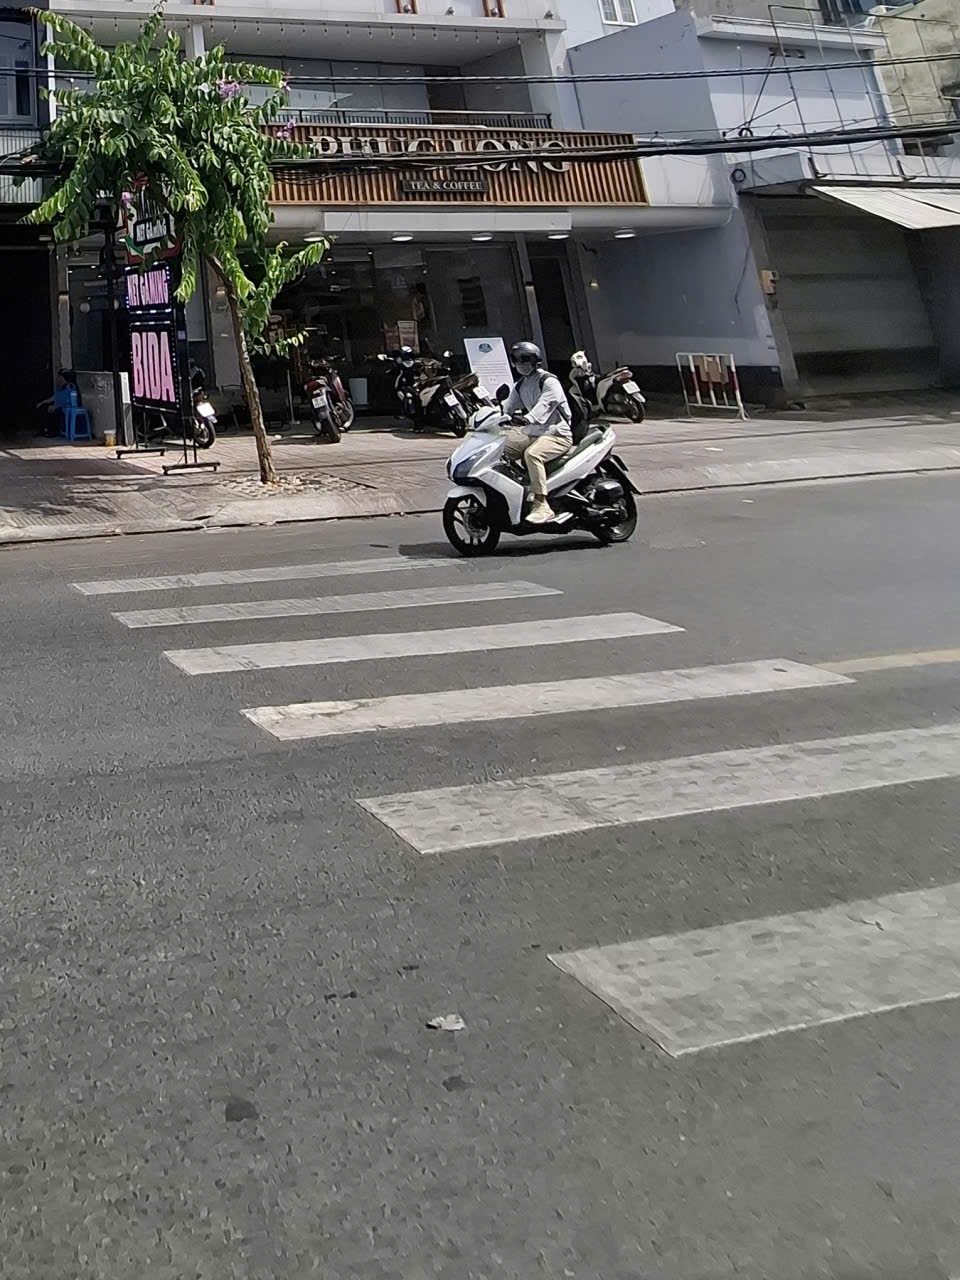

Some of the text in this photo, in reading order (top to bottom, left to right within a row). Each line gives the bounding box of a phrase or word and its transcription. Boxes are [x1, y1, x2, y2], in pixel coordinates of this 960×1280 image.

[410, 181, 483, 190] TEA & COFFEE
[131, 331, 176, 402] BIDA
